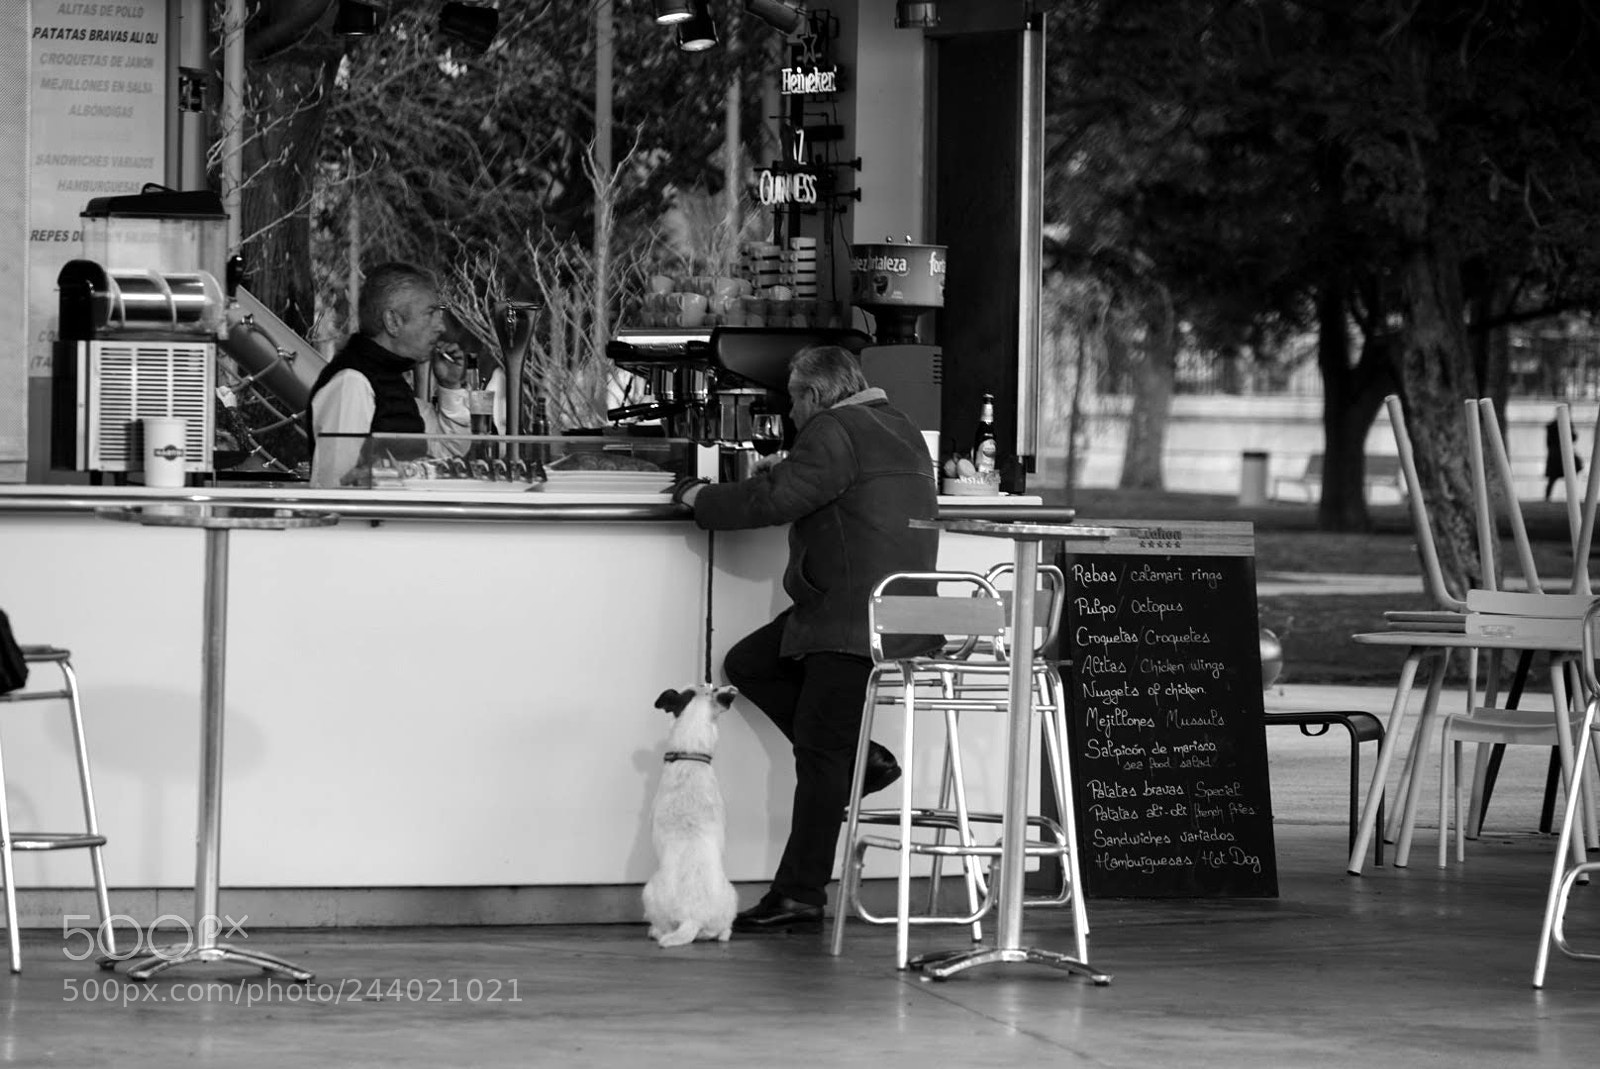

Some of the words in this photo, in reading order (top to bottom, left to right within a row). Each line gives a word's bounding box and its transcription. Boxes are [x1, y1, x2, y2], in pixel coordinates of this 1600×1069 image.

[57, 3, 98, 17] ALITAS
[100, 5, 114, 18] DE
[115, 5, 144, 19] POLLO
[32, 27, 87, 41] PATATAS
[88, 29, 129, 43] BRAVAS
[130, 31, 144, 44] ALI
[145, 32, 159, 45] OLI
[40, 52, 109, 68] CROQUETAS
[110, 55, 124, 68] DE
[40, 78, 110, 93] MEJILLONES
[111, 80, 125, 93] EN
[35, 154, 110, 168] SANDWICHES
[30, 229, 69, 243] REPES
[1071, 562, 1117, 588] Rabas
[1130, 563, 1184, 584] calamari
[1191, 567, 1223, 590] rings
[1074, 597, 1117, 622] Pulpo
[1131, 596, 1184, 622] Octopus
[1081, 654, 1127, 677] Alitas
[1140, 657, 1185, 676] Chicken
[1190, 658, 1225, 679] wings
[1082, 680, 1140, 706] Nuggets
[1147, 682, 1161, 706] of
[1086, 706, 1155, 738] Mejillones
[1151, 741, 1167, 755] de
[1173, 739, 1217, 755] marisco
[1123, 760, 1144, 771] sea
[1149, 756, 1171, 777] food
[1179, 756, 1212, 768] salad
[1086, 778, 1137, 800] Patatas
[1142, 780, 1185, 798] bravas
[1194, 780, 1244, 802] Special
[1088, 803, 1139, 822] Patatas
[1092, 828, 1171, 848] Sandwiches
[1179, 827, 1235, 843] variados
[1095, 851, 1193, 875] Hamburguesas
[1201, 849, 1226, 868] Hot
[1228, 845, 1262, 874] Dog
